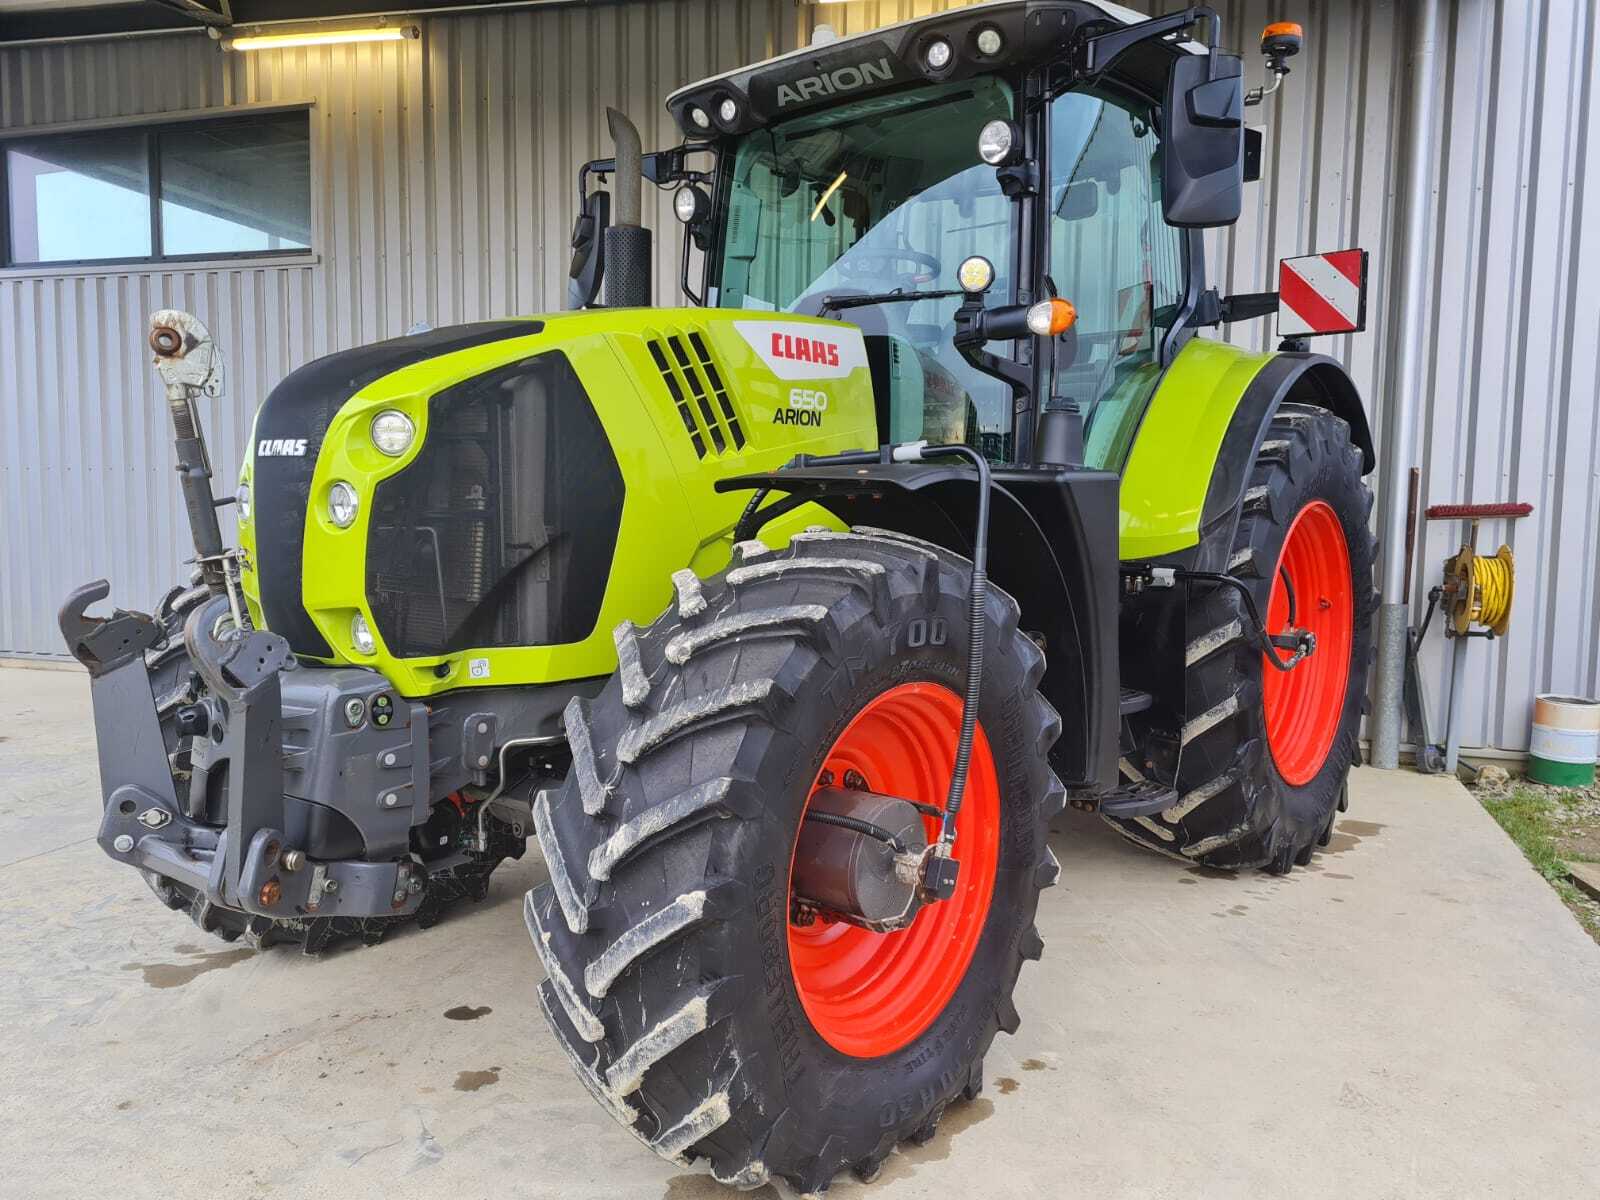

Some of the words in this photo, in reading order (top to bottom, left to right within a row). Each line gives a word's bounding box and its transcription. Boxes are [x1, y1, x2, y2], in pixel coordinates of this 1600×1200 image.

[776, 57, 894, 107] ARION
[771, 332, 839, 367] CLAAS
[789, 388, 828, 411] 650
[772, 407, 822, 427] ARION
[258, 438, 308, 457] CLAAS
